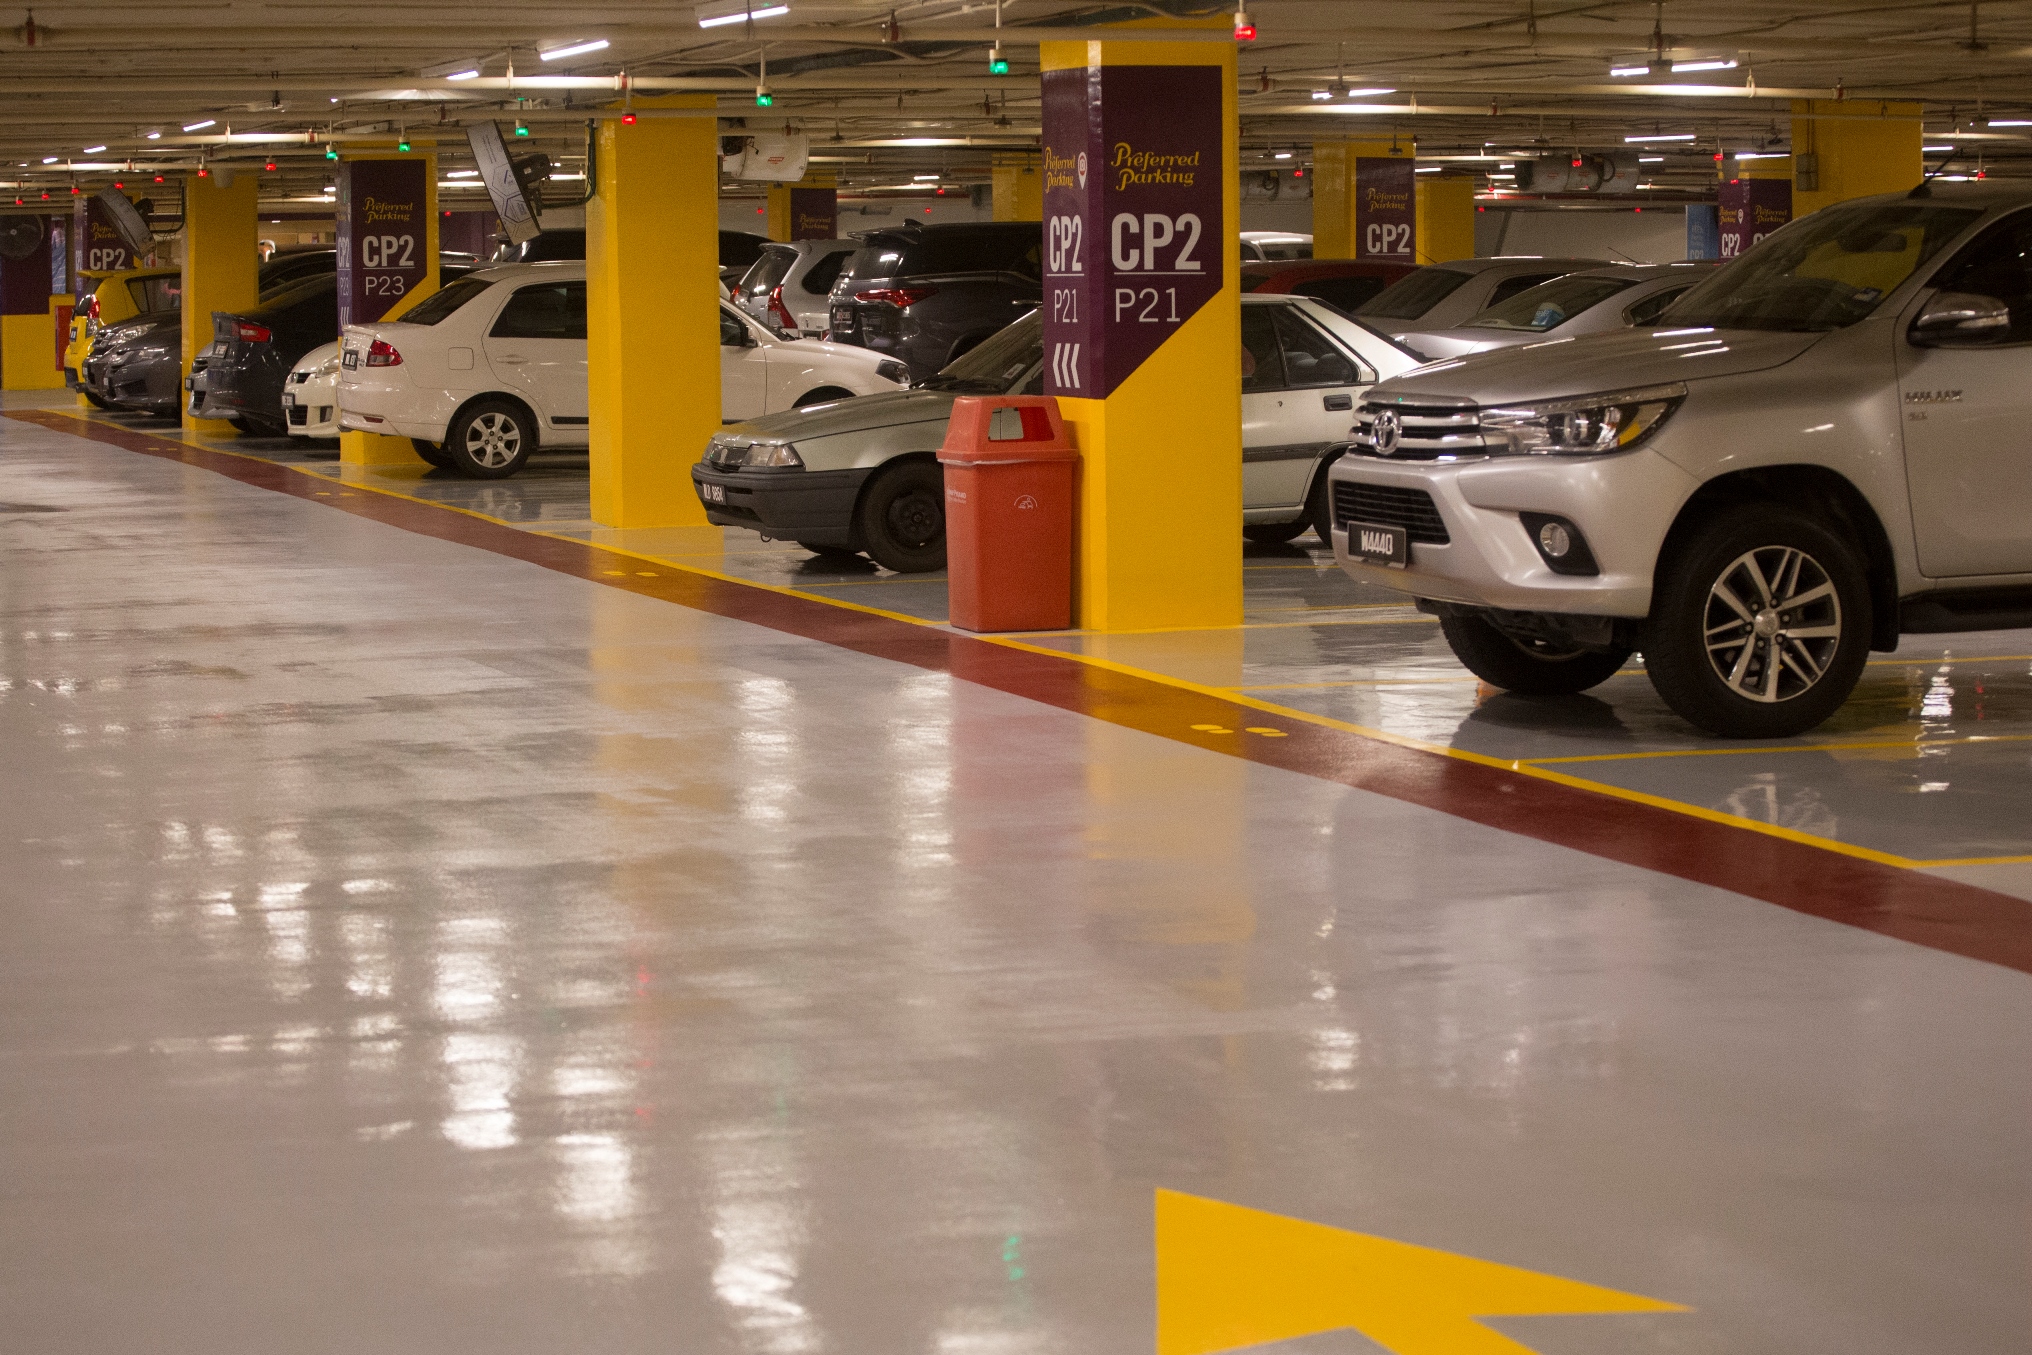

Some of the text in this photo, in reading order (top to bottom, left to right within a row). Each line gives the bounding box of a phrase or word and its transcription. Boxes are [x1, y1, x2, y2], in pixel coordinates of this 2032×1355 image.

[1044, 146, 1076, 174] Preferred
[1111, 142, 1200, 171] Preferred
[1046, 172, 1074, 193] Parking
[1116, 168, 1195, 191] Parking
[362, 197, 413, 213] Preferred
[1366, 187, 1409, 202] Preferred
[1368, 201, 1406, 212] Parking
[365, 210, 410, 224] Parking
[362, 235, 415, 267] CP2
[1049, 215, 1082, 272] CP2
[1111, 213, 1202, 271] CP2
[1366, 224, 1411, 254] CP2
[1721, 233, 1741, 256] CP2
[89, 248, 126, 270] CP2
[337, 237, 350, 268] CP2
[365, 276, 405, 295] P23
[1054, 289, 1078, 323] P21
[1115, 287, 1181, 322] P21
